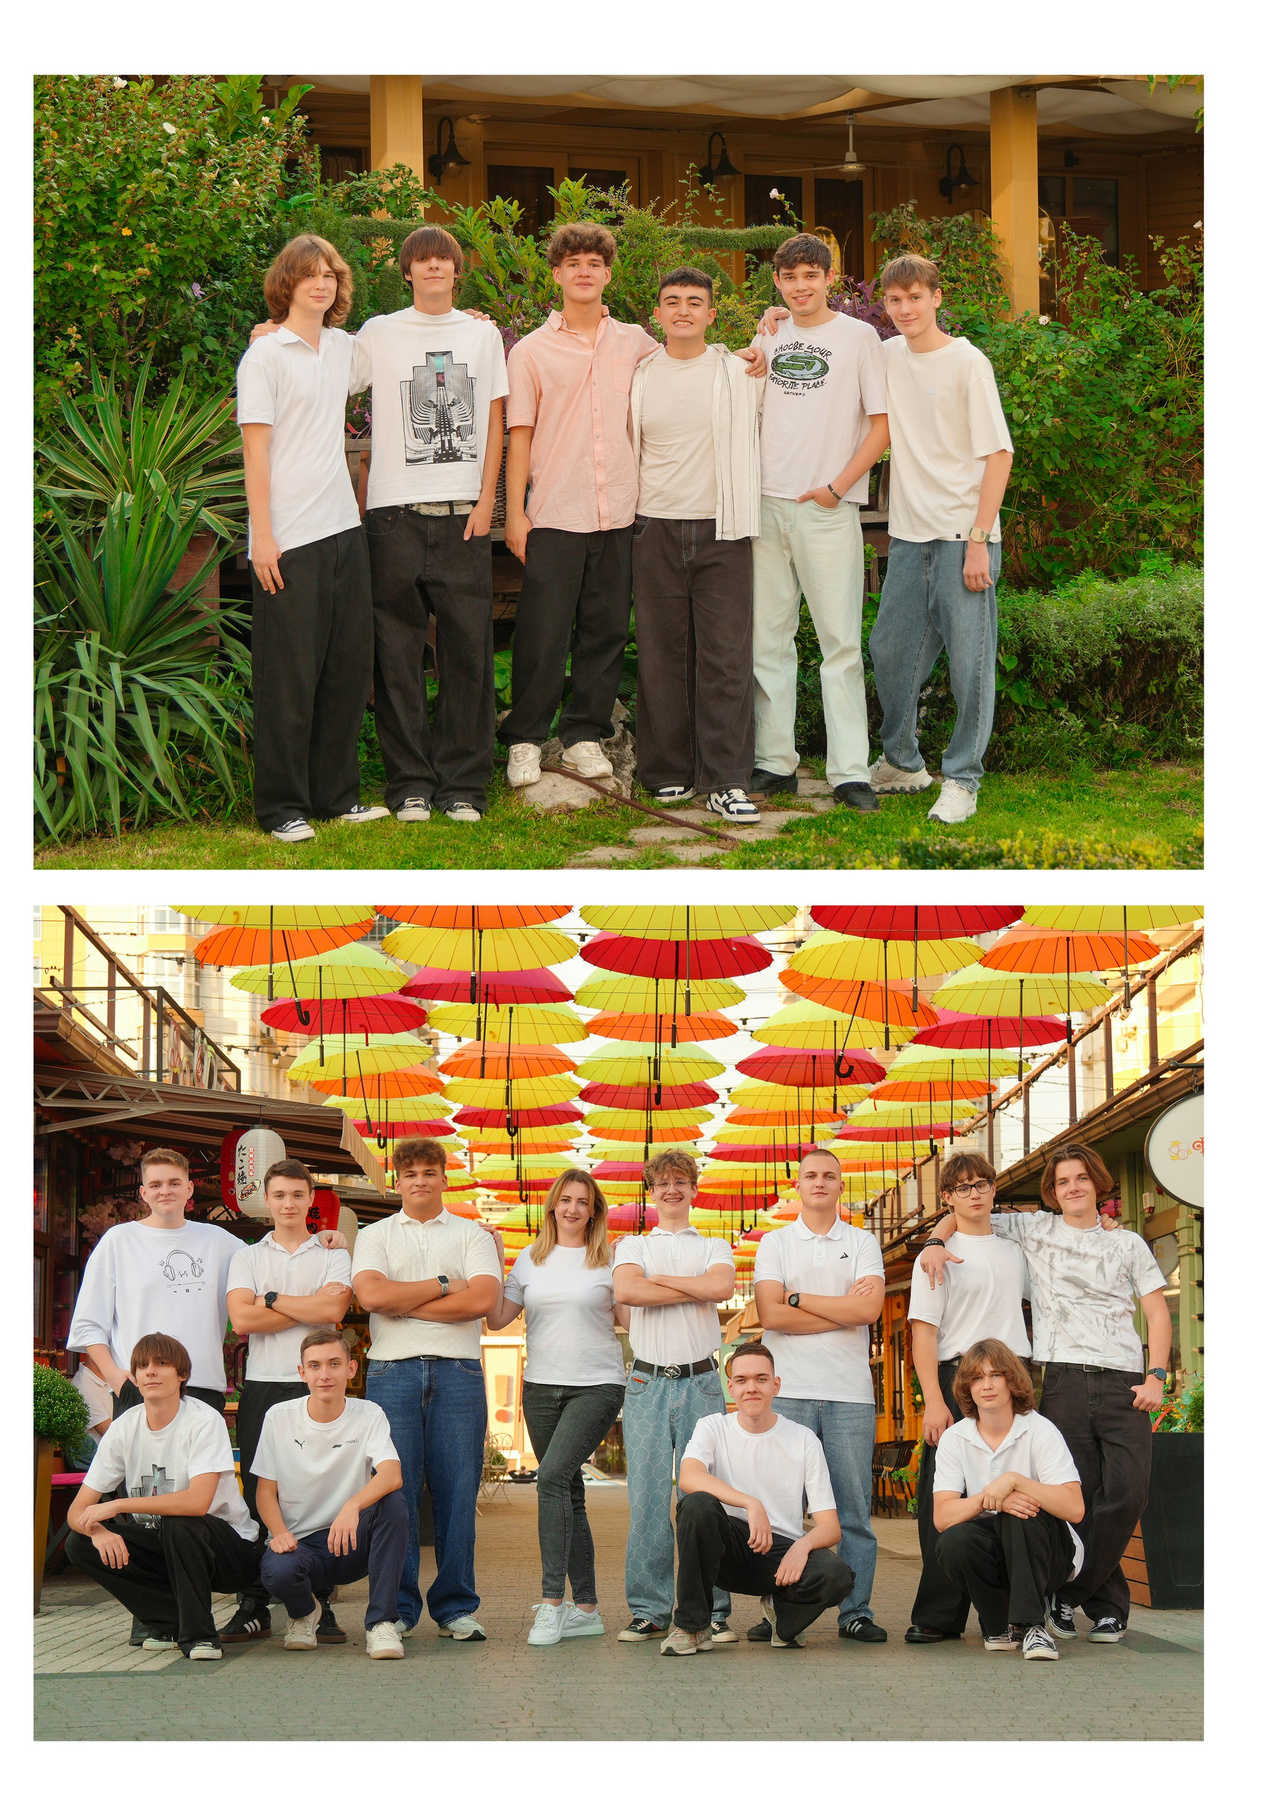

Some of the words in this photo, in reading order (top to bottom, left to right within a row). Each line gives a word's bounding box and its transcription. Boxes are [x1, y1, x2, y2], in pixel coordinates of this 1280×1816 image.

[774, 340, 805, 356] CHOOSE
[804, 344, 833, 361] YOUR
[769, 373, 800, 390] FAVORITE
[801, 378, 827, 390] PLACE
